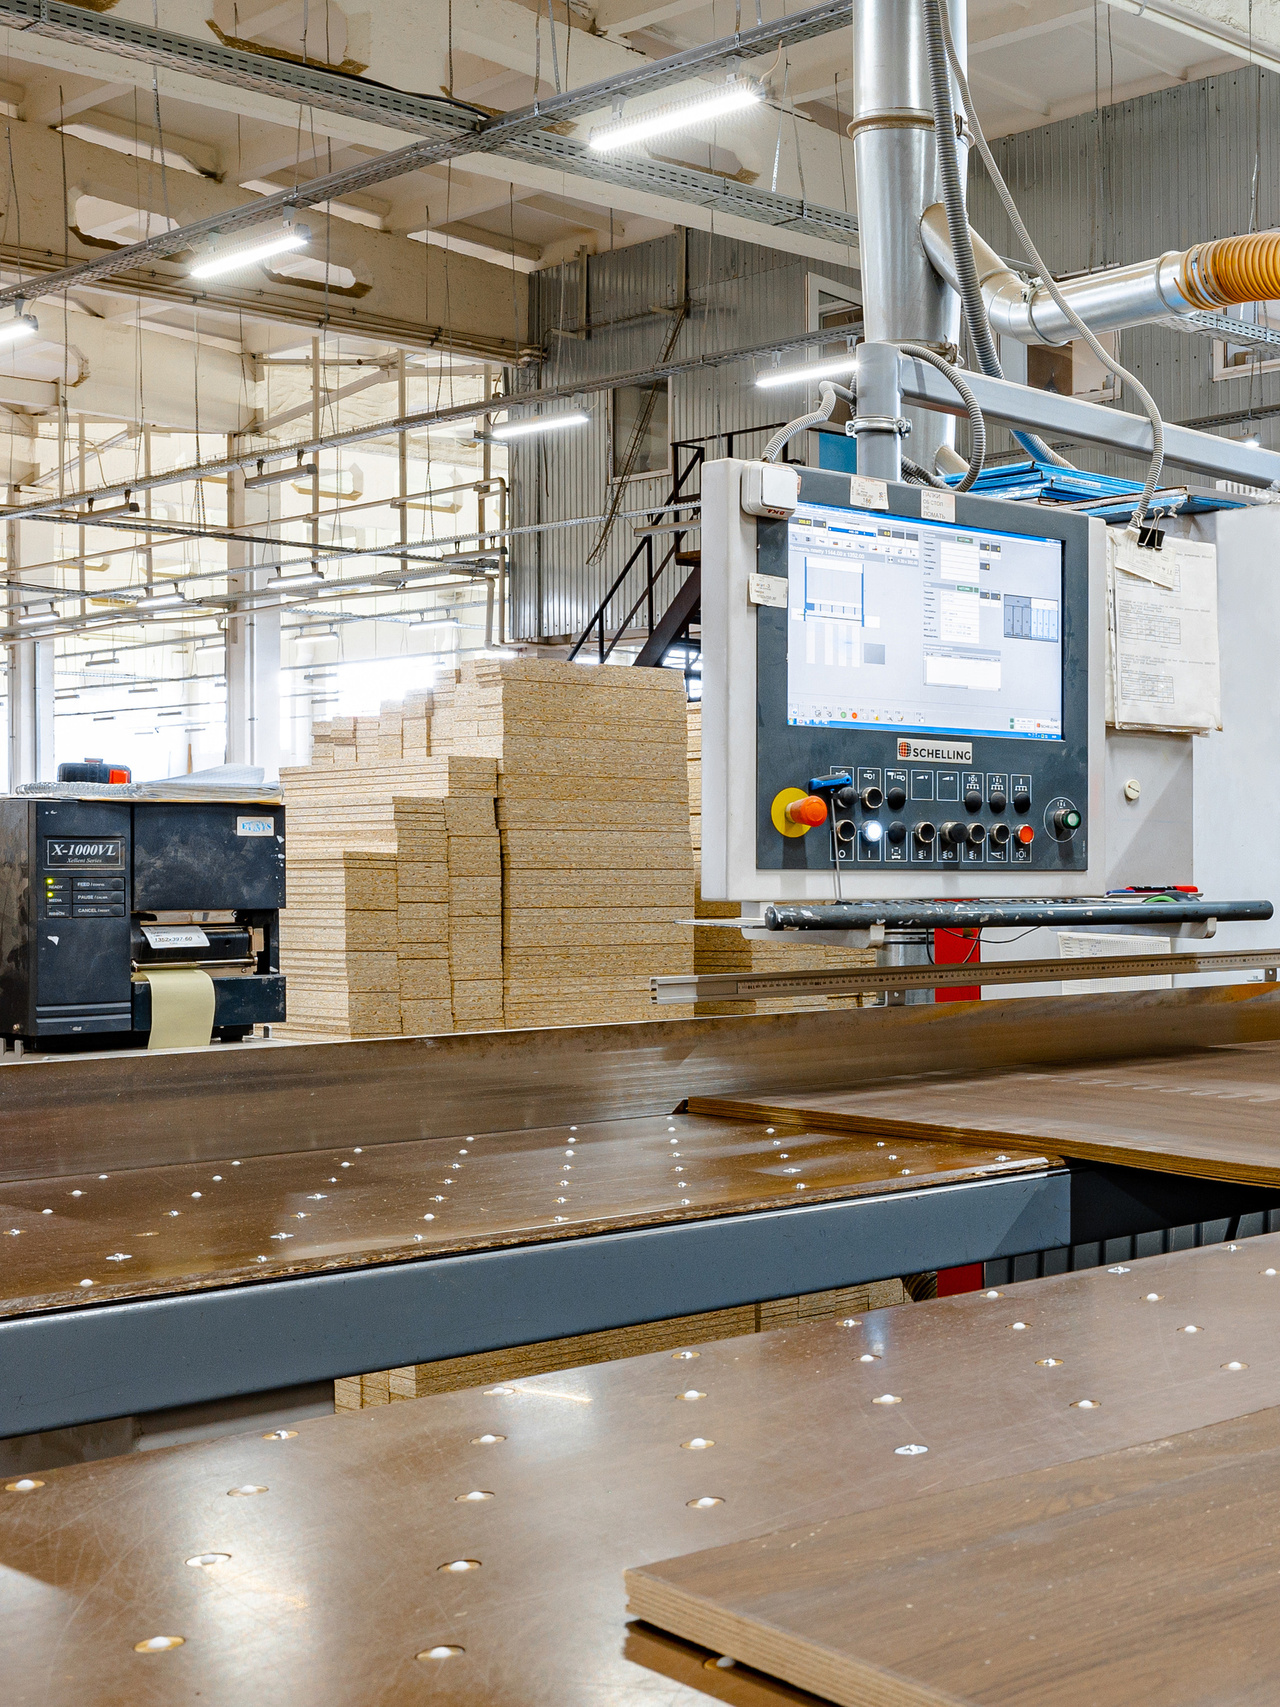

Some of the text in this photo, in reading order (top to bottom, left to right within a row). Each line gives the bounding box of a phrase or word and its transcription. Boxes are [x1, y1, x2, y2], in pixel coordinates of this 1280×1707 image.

[922, 510, 946, 520] ЛОМАТЬ
[913, 747, 971, 761] SCHELLING
[51, 844, 117, 856] X-1000VL
